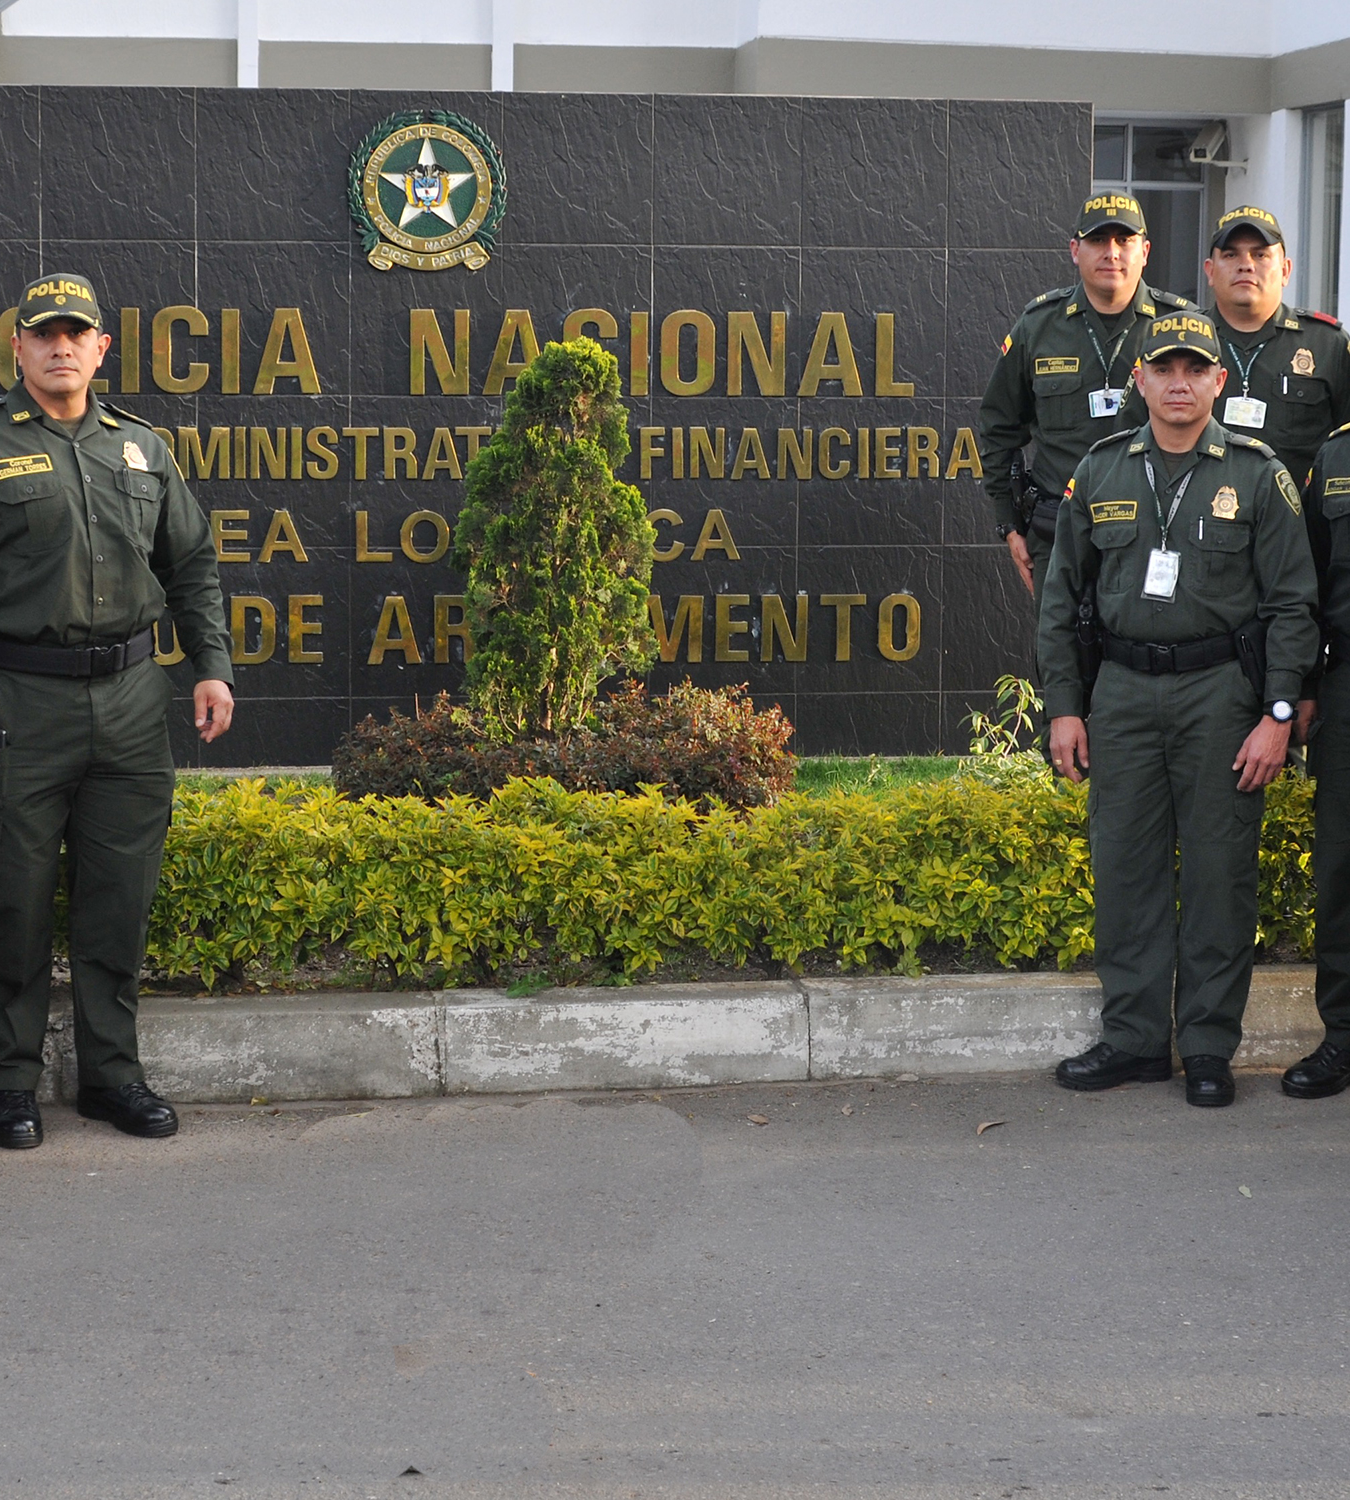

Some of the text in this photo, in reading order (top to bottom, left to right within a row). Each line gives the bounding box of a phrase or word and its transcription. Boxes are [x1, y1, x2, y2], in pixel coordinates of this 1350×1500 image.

[420, 127, 438, 138] DE
[1084, 196, 1139, 214] POLICIA
[1218, 207, 1275, 229] POLICIA
[373, 214, 413, 248] POLICIA
[380, 246, 475, 267] DIOS Y PATRIA
[27, 279, 93, 302] POLICIA
[1151, 317, 1214, 340] POLICIA
[9, 458, 34, 468] Coronel
[639, 426, 985, 481] FINANCIERA
[24, 462, 47, 472] TORRES
[1109, 509, 1134, 518] VARGAS
[230, 594, 325, 666] DE
